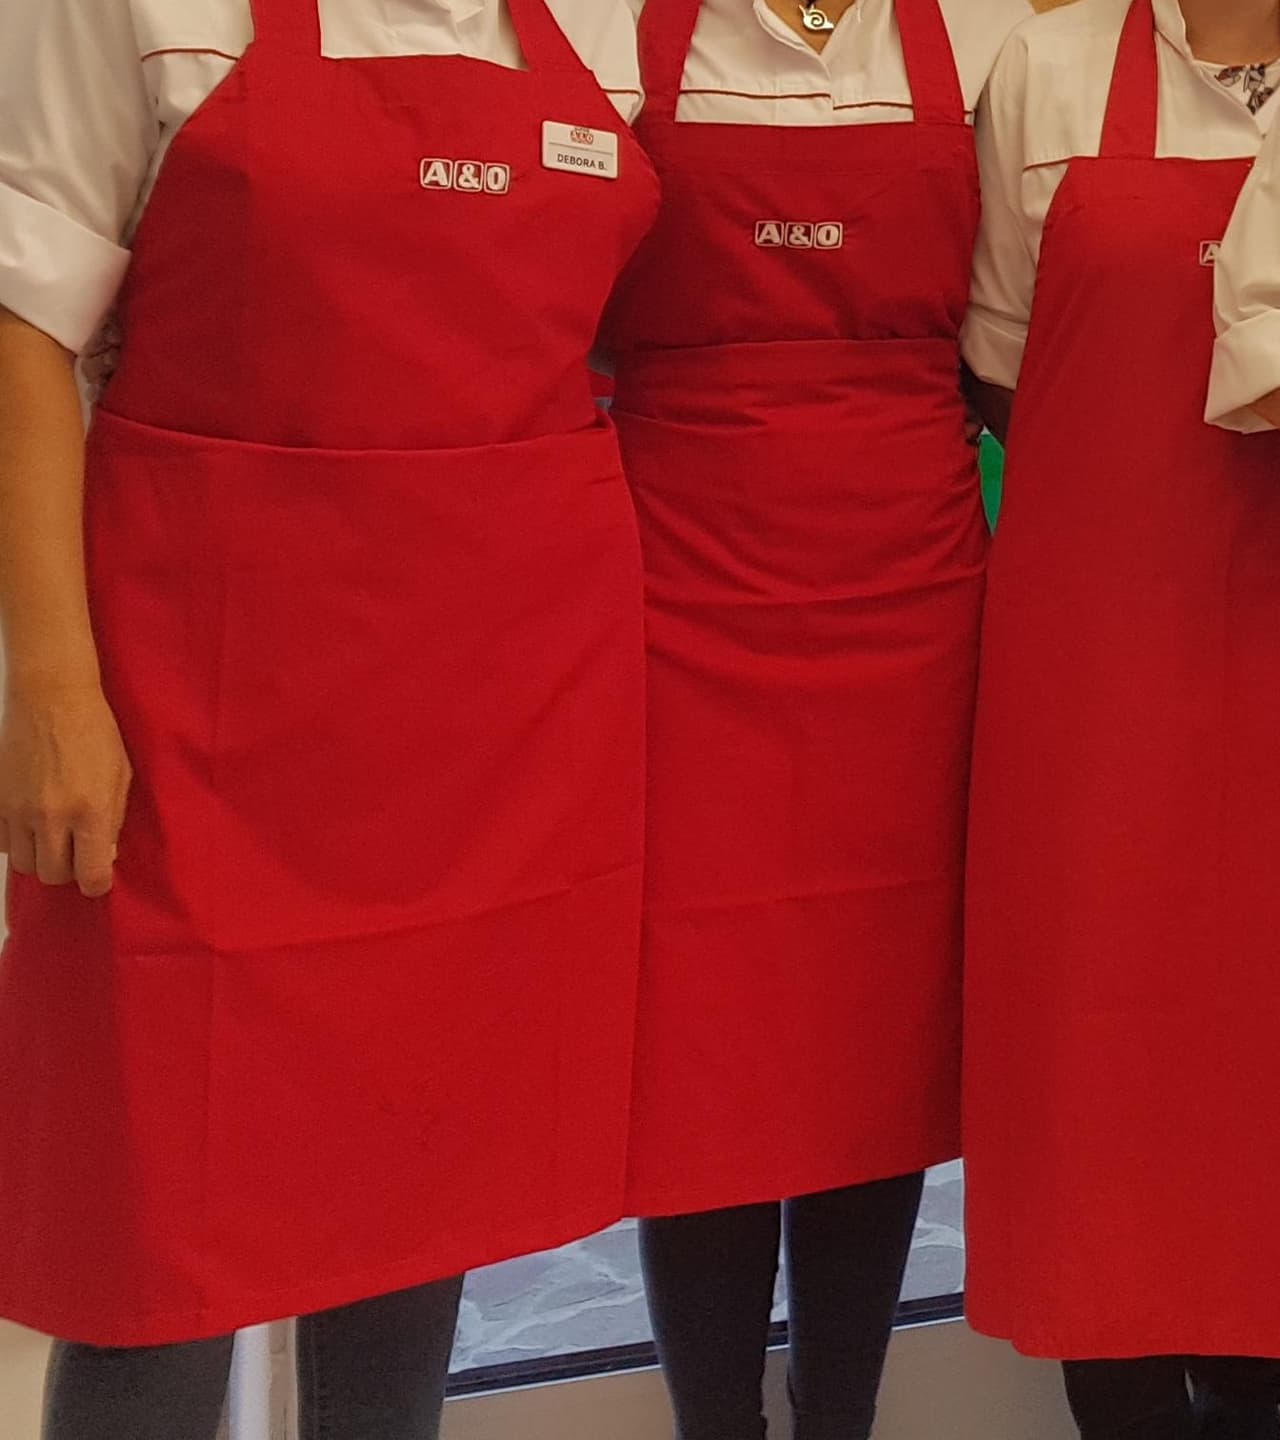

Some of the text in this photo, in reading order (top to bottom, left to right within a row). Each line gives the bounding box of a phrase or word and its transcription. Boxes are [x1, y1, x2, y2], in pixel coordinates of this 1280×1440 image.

[556, 153, 596, 169] DEBORA
[422, 159, 508, 193] A&O
[757, 222, 840, 248] A&O
